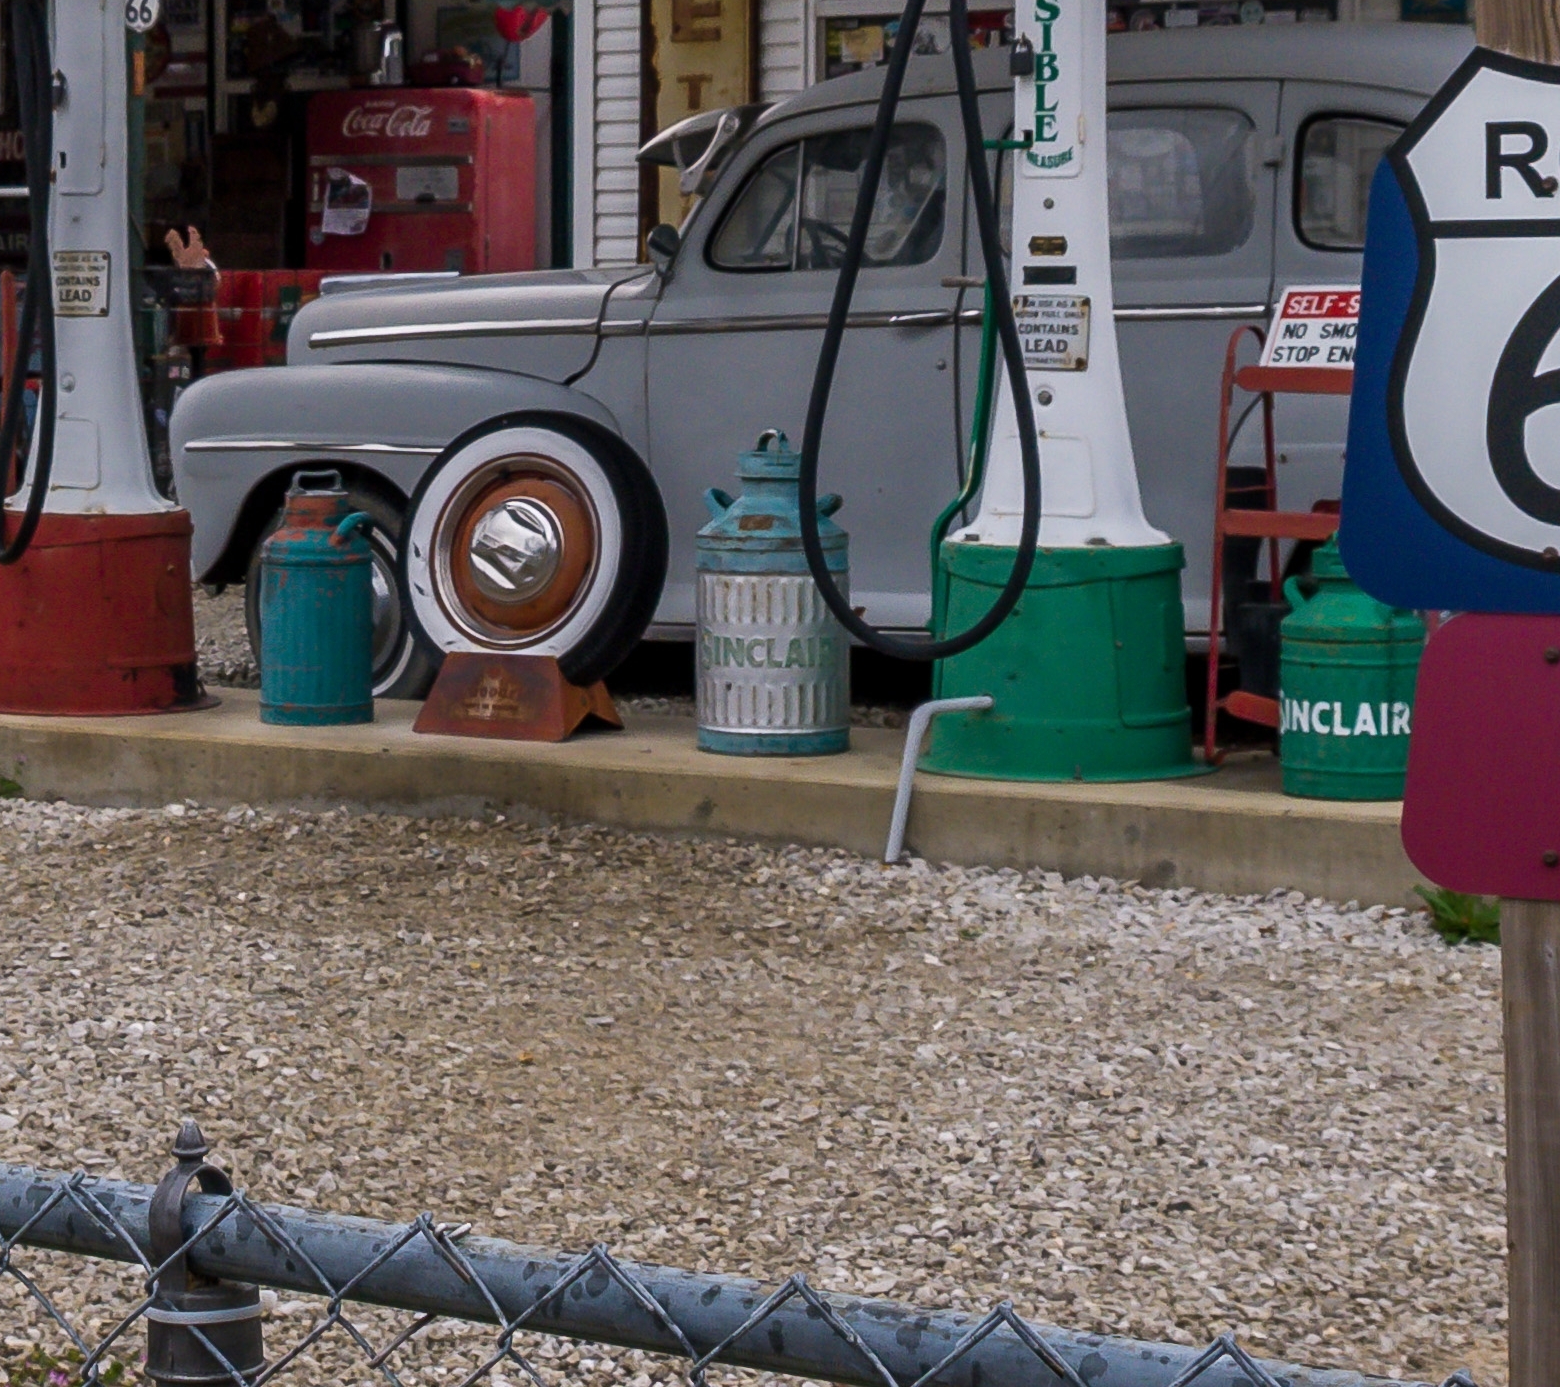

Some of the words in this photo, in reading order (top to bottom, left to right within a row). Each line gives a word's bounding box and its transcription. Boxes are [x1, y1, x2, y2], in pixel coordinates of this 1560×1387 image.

[341, 105, 435, 138] Coca-Cola
[58, 288, 93, 303] LEAD
[1018, 322, 1080, 336] CONTAINS
[1281, 323, 1309, 340] NO
[1319, 322, 1358, 340] SMO
[1024, 338, 1069, 354] LEAD
[1271, 345, 1321, 363] STOP
